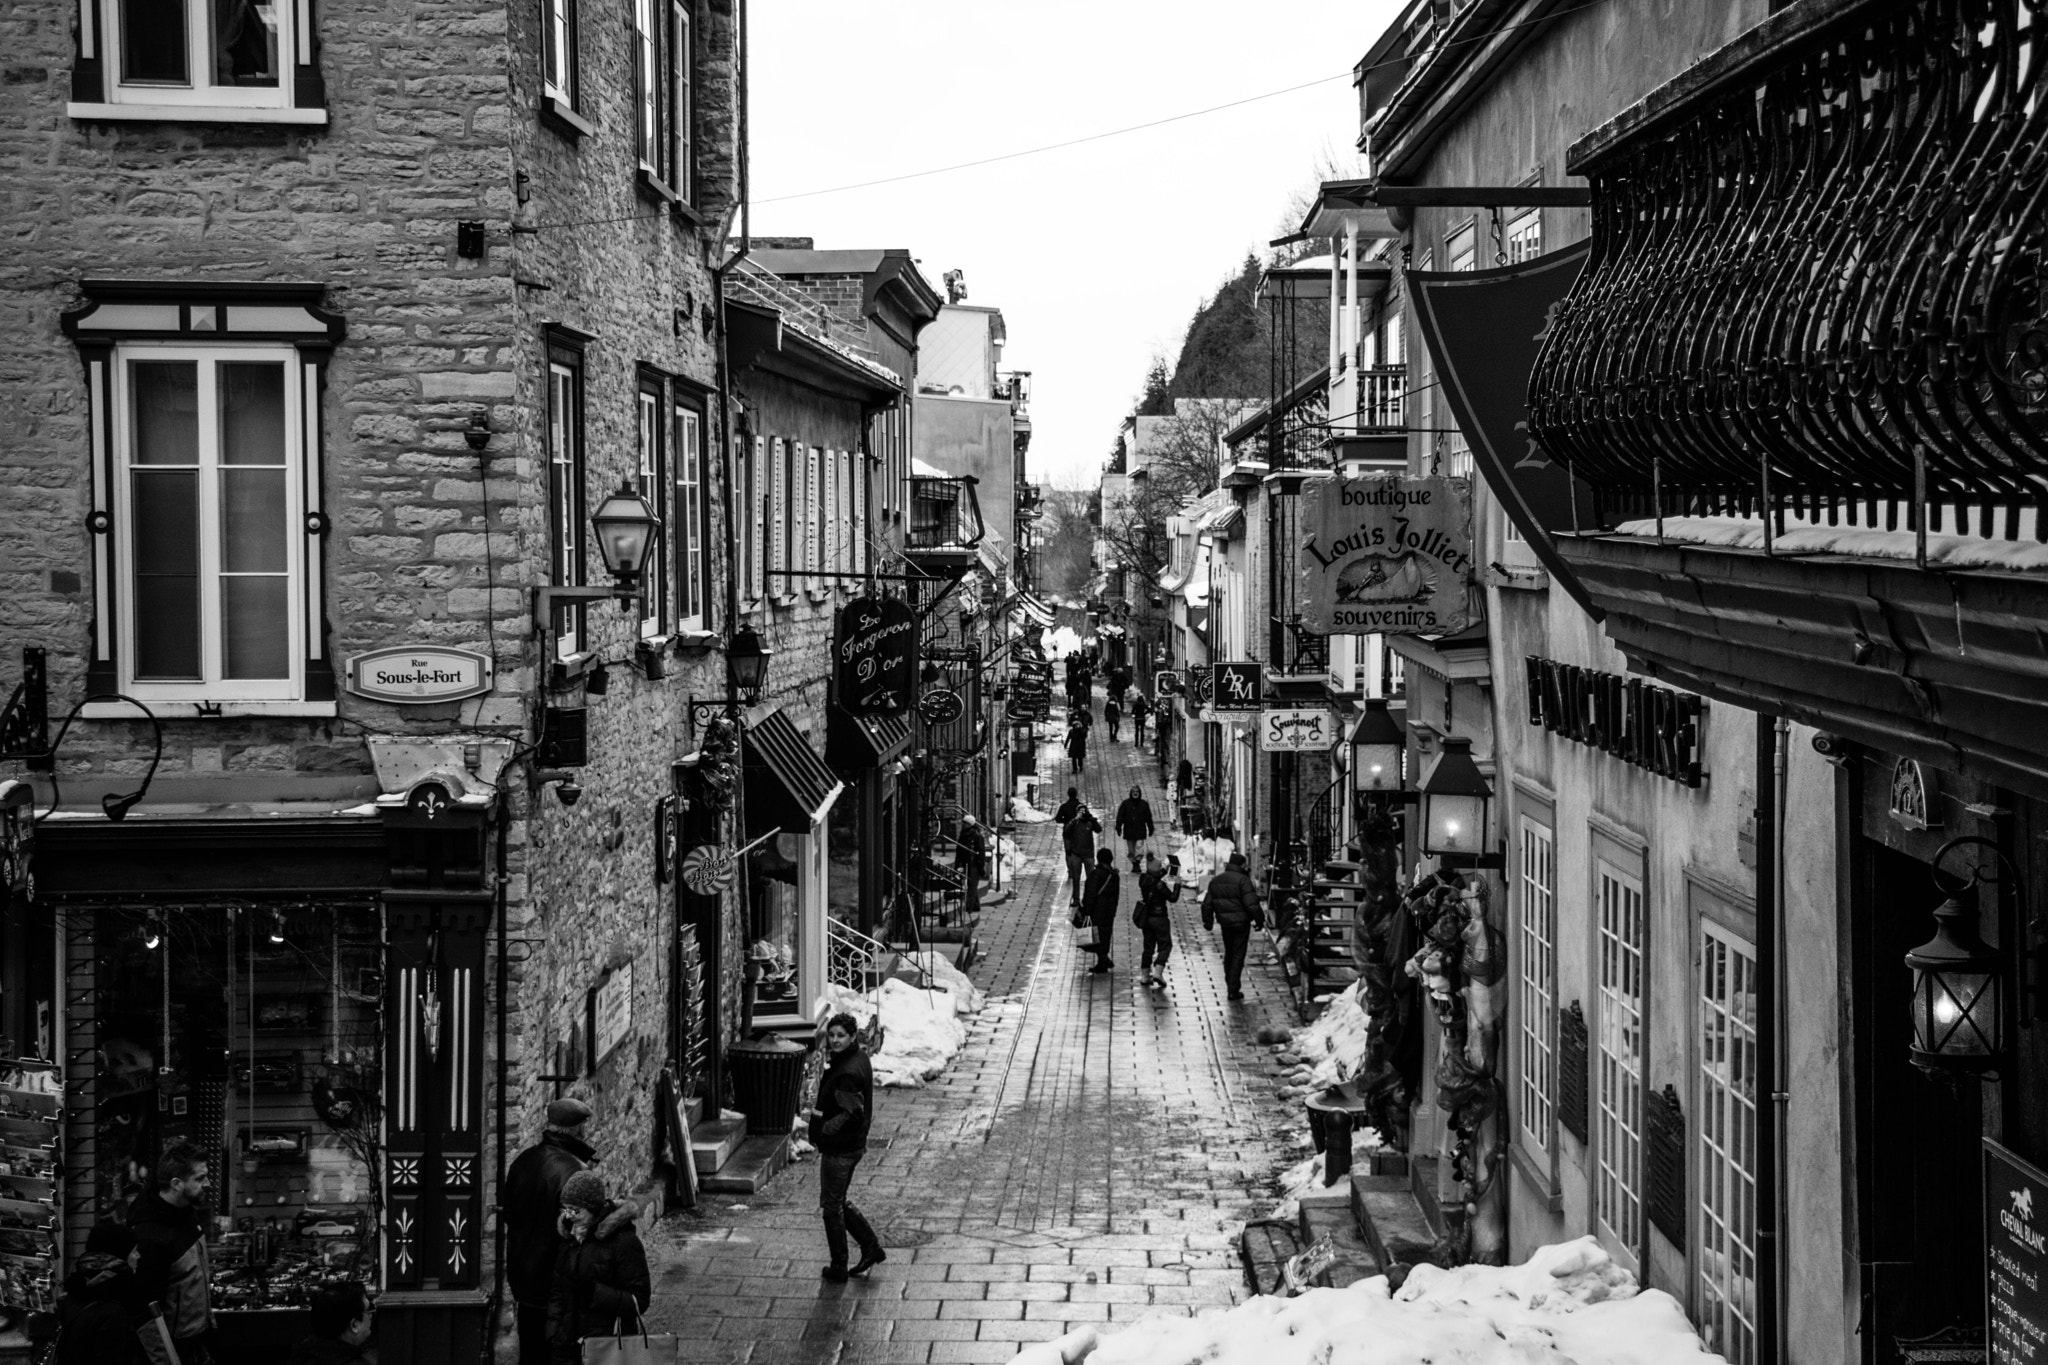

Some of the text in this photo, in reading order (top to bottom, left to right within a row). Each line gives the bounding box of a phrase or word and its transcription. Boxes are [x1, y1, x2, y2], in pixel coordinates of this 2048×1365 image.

[1341, 480, 1432, 512] boutique
[1302, 515, 1469, 573] Louis Jolliet
[860, 614, 881, 631] Le
[1333, 605, 1437, 629] souvenirs
[841, 621, 912, 663] Forgeron
[411, 659, 428, 667] Rue
[376, 670, 462, 684] Sous-le-Fort
[1525, 655, 1701, 788] FUNICULAIRE
[1903, 792, 1912, 813] 12
[700, 856, 726, 870] Bon
[688, 868, 722, 886] Bons
[2000, 1209, 2024, 1239] CHEVAL
[2024, 1224, 2046, 1254] BLANC
[1997, 1250, 2020, 1279] Smoked
[1997, 1274, 2015, 1296] pizza
[1997, 1298, 2046, 1344] croque-monsieur
[2011, 1332, 2020, 1348] au
